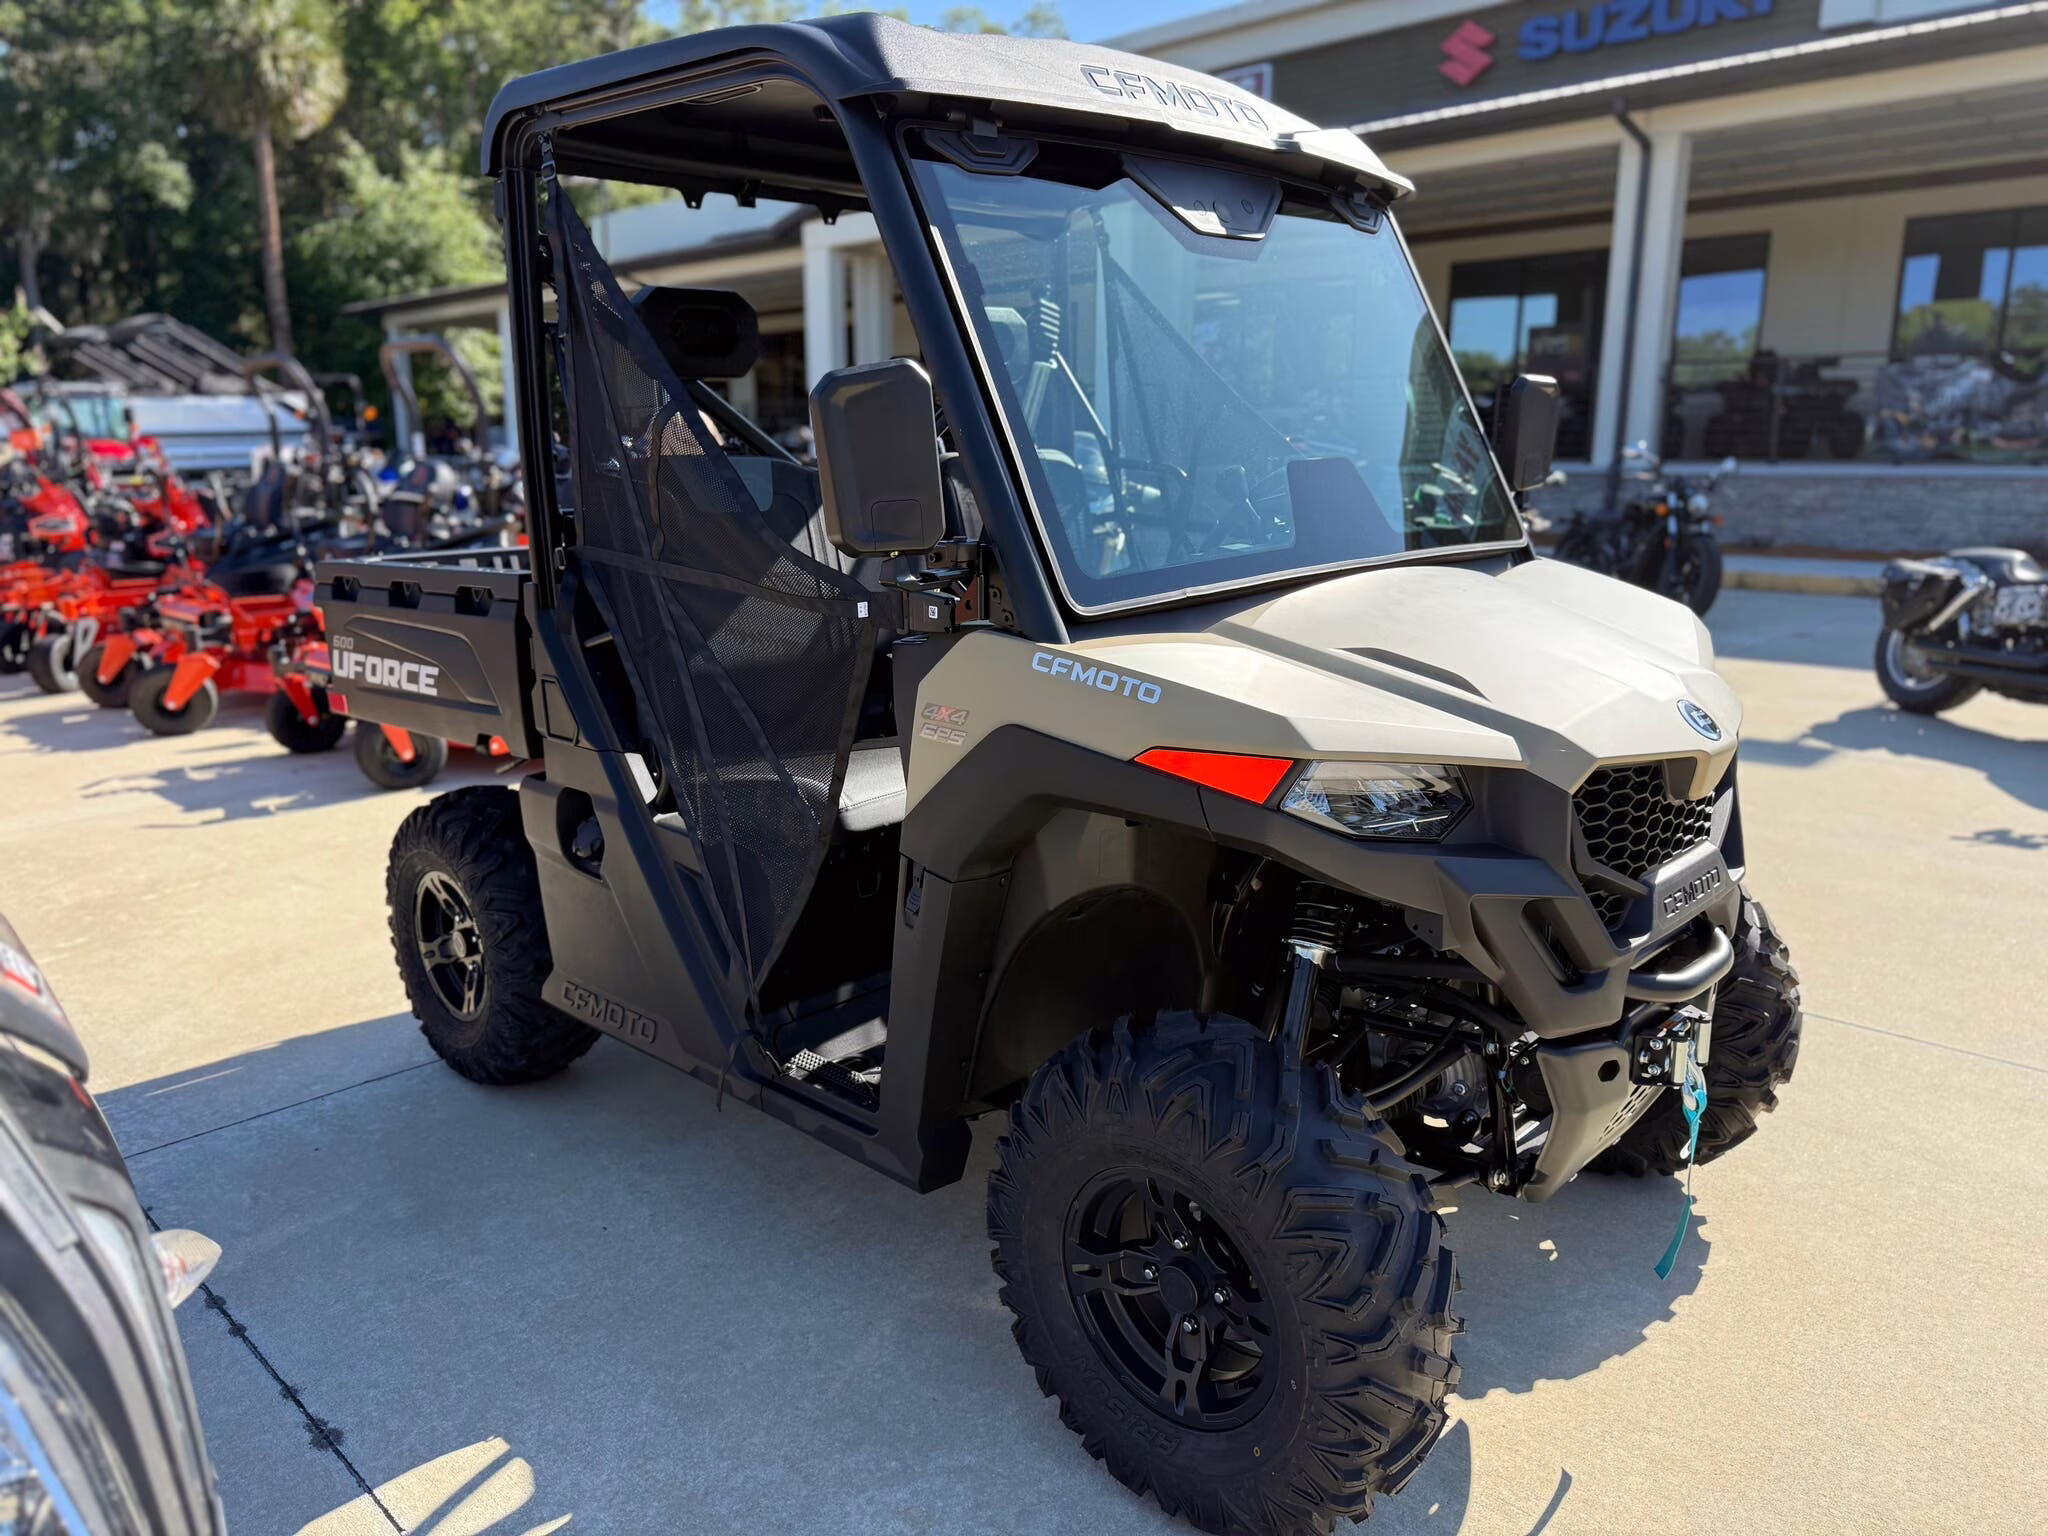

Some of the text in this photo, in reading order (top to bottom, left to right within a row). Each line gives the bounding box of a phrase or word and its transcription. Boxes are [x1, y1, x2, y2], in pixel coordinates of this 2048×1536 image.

[1079, 63, 1269, 131] CFMOTO
[332, 635, 354, 650] 600
[331, 648, 440, 697] UFORCE
[1031, 651, 1163, 705] CFMOTO
[918, 723, 969, 746] EPS
[1662, 865, 1721, 919] CFMOTO
[562, 979, 658, 1045] CFMOTO
